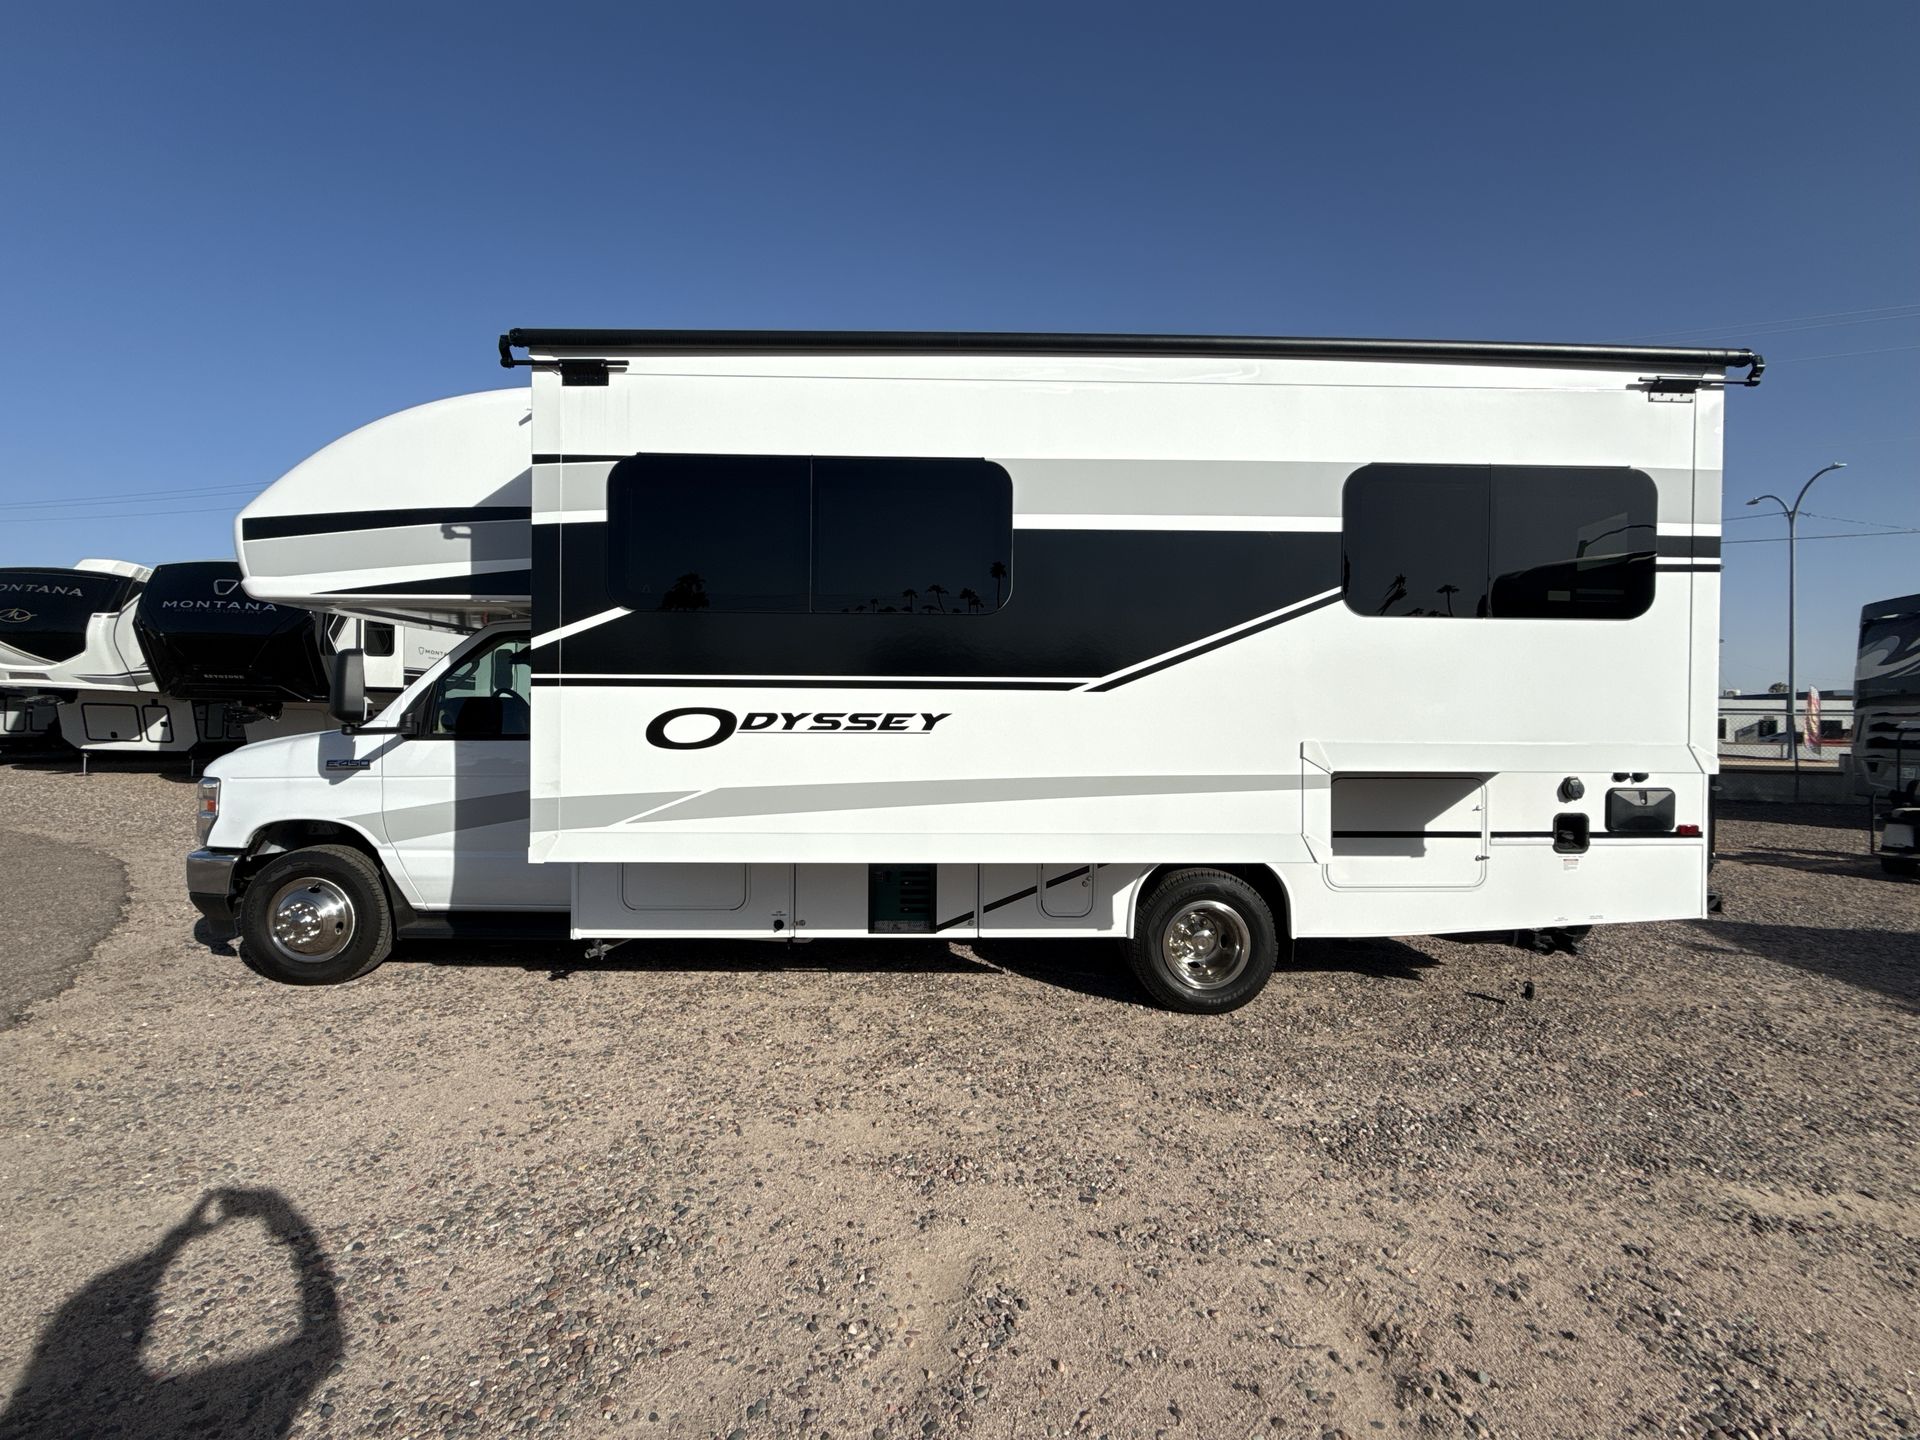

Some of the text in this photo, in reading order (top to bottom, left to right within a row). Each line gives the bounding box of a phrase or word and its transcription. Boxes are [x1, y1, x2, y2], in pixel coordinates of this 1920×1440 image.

[0, 584, 83, 597] ONTANA
[162, 600, 277, 612] MONTANA
[645, 706, 953, 750] ODYSSEY
